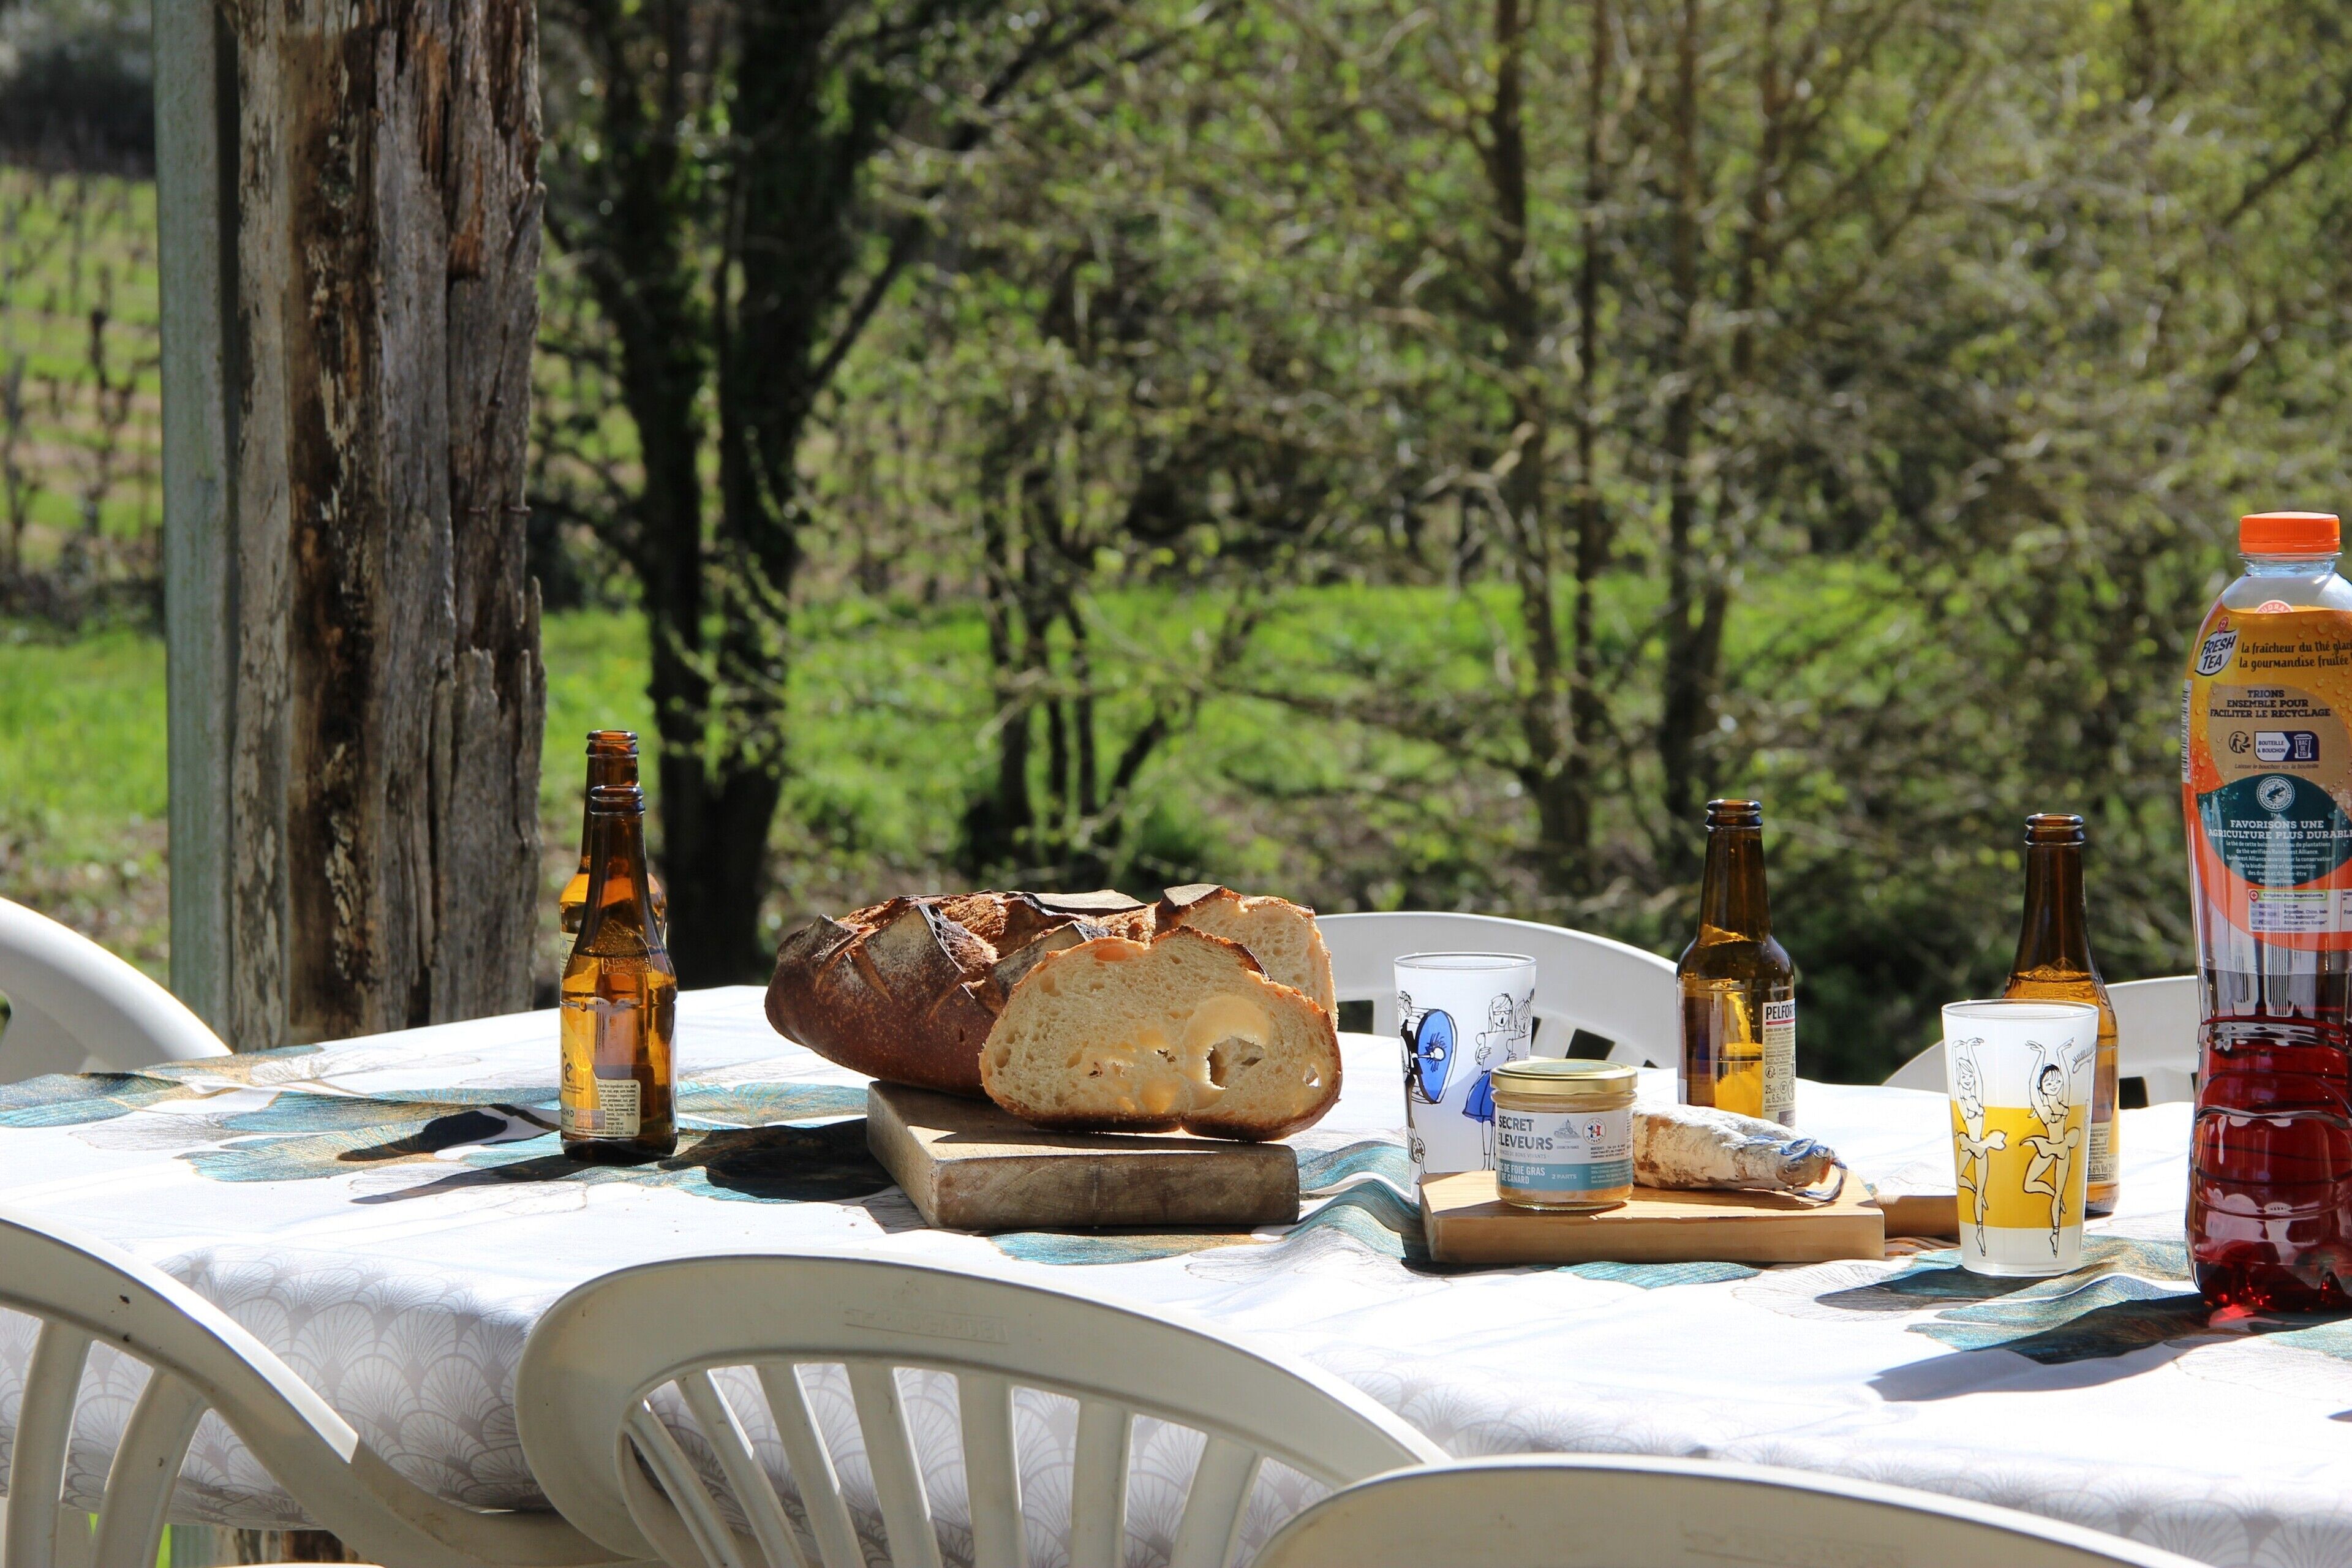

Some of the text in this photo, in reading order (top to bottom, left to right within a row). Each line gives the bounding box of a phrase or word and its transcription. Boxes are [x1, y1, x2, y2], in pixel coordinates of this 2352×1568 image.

[2201, 635, 2236, 656] FRESH
[2241, 642, 2249, 654] la
[2252, 642, 2295, 655] fraîcheur
[2299, 641, 2313, 652] du
[2315, 640, 2330, 652] thé
[2203, 654, 2222, 670] TEA
[2239, 654, 2349, 672] la gourmandise fruitée
[2271, 709, 2331, 717] RECYCLAGE
[2230, 820, 2297, 829] FAVORISONS
[2208, 829, 2272, 839] AGRICULTURE
[1499, 1115, 1534, 1132] SECRET
[1504, 1163, 1510, 1172] DE
[1511, 1165, 1525, 1175] FOIE
[1526, 1166, 1545, 1176] GRAS
[1501, 1172, 1529, 1184] DE CANARD
